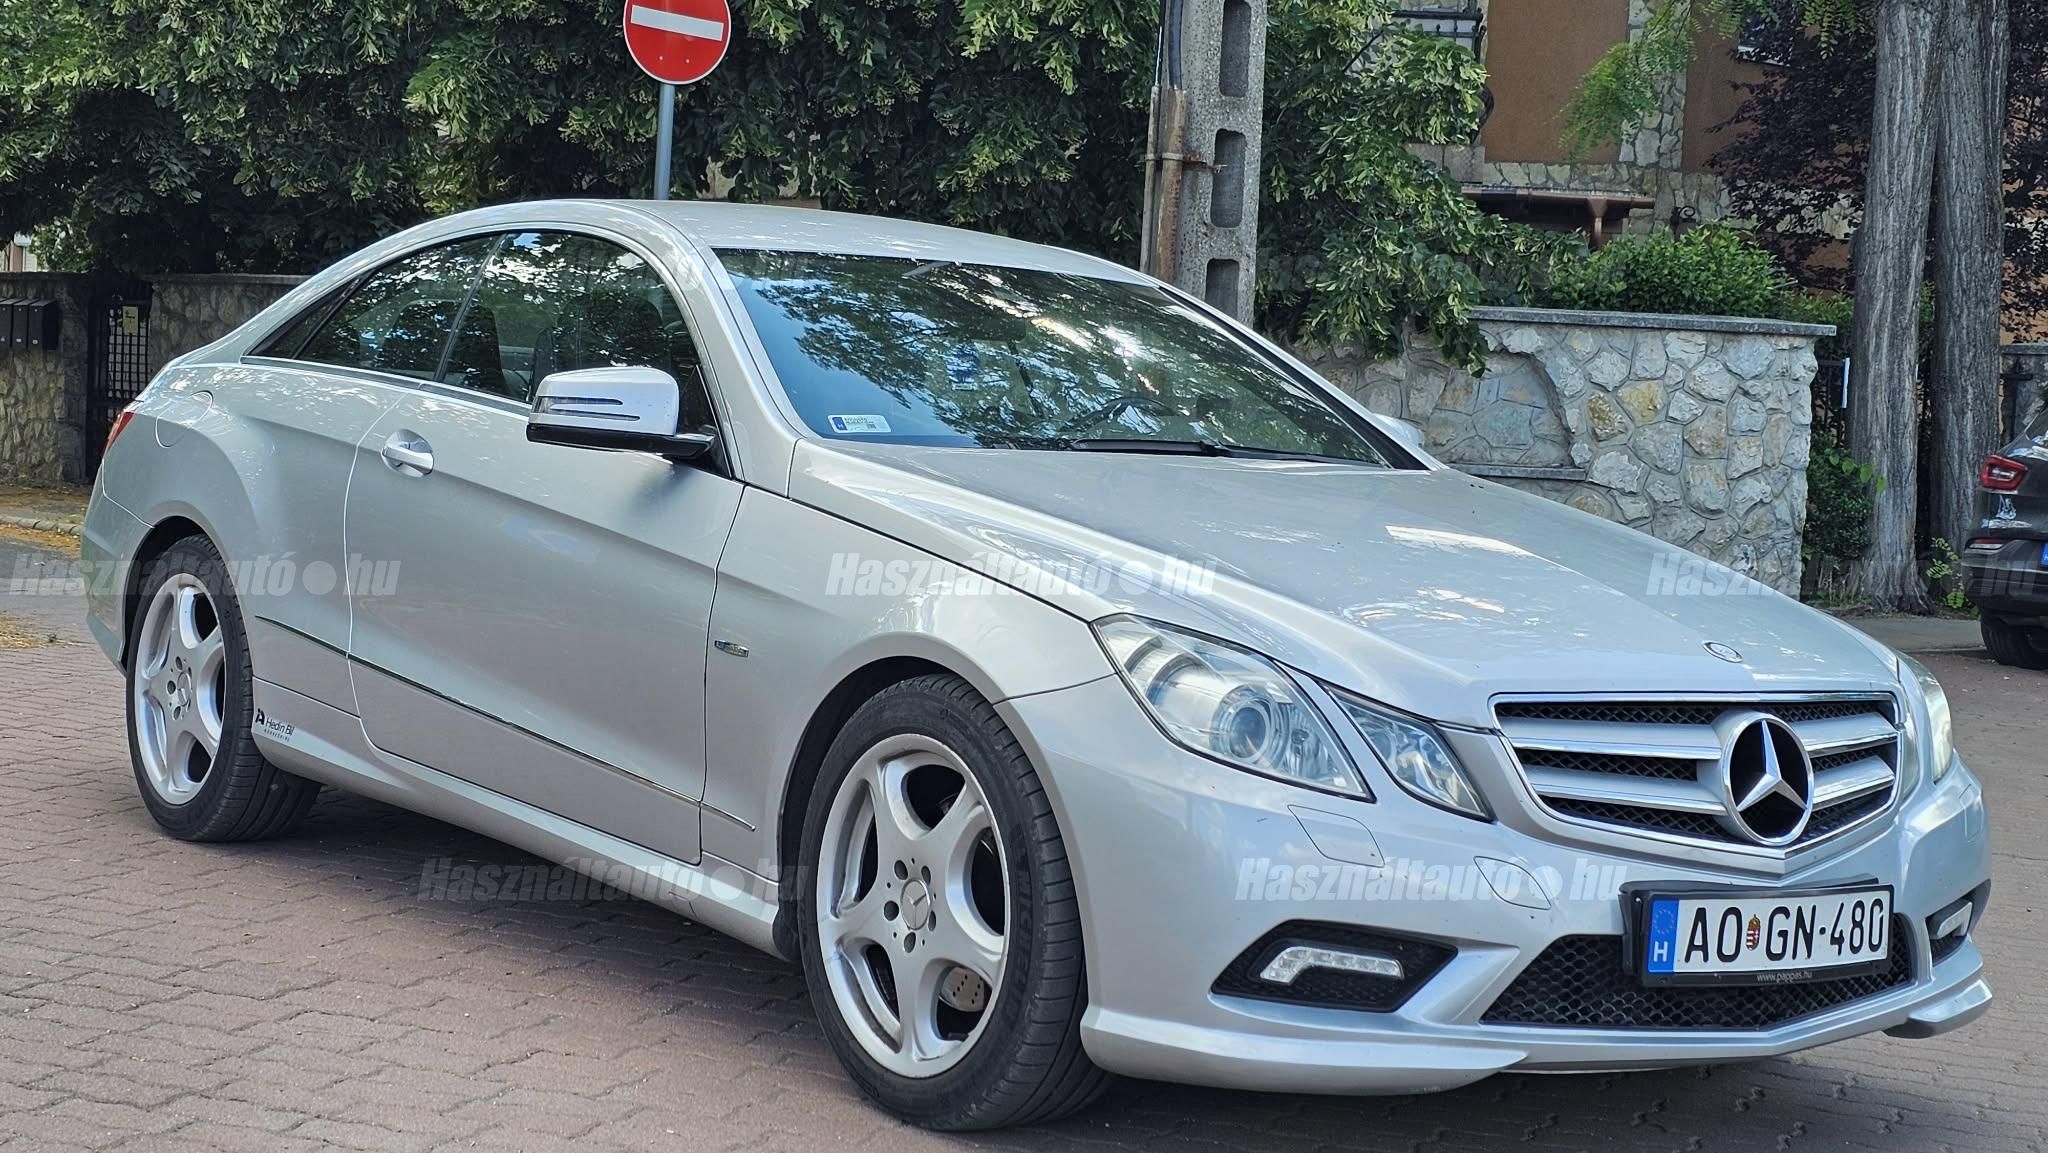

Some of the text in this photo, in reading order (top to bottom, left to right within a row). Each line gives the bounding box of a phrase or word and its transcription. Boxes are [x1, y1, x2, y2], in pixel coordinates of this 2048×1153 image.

[1684, 906, 1743, 963] AO
[1653, 941, 1669, 963] H
[1756, 970, 1812, 984] www.pappas.hu
